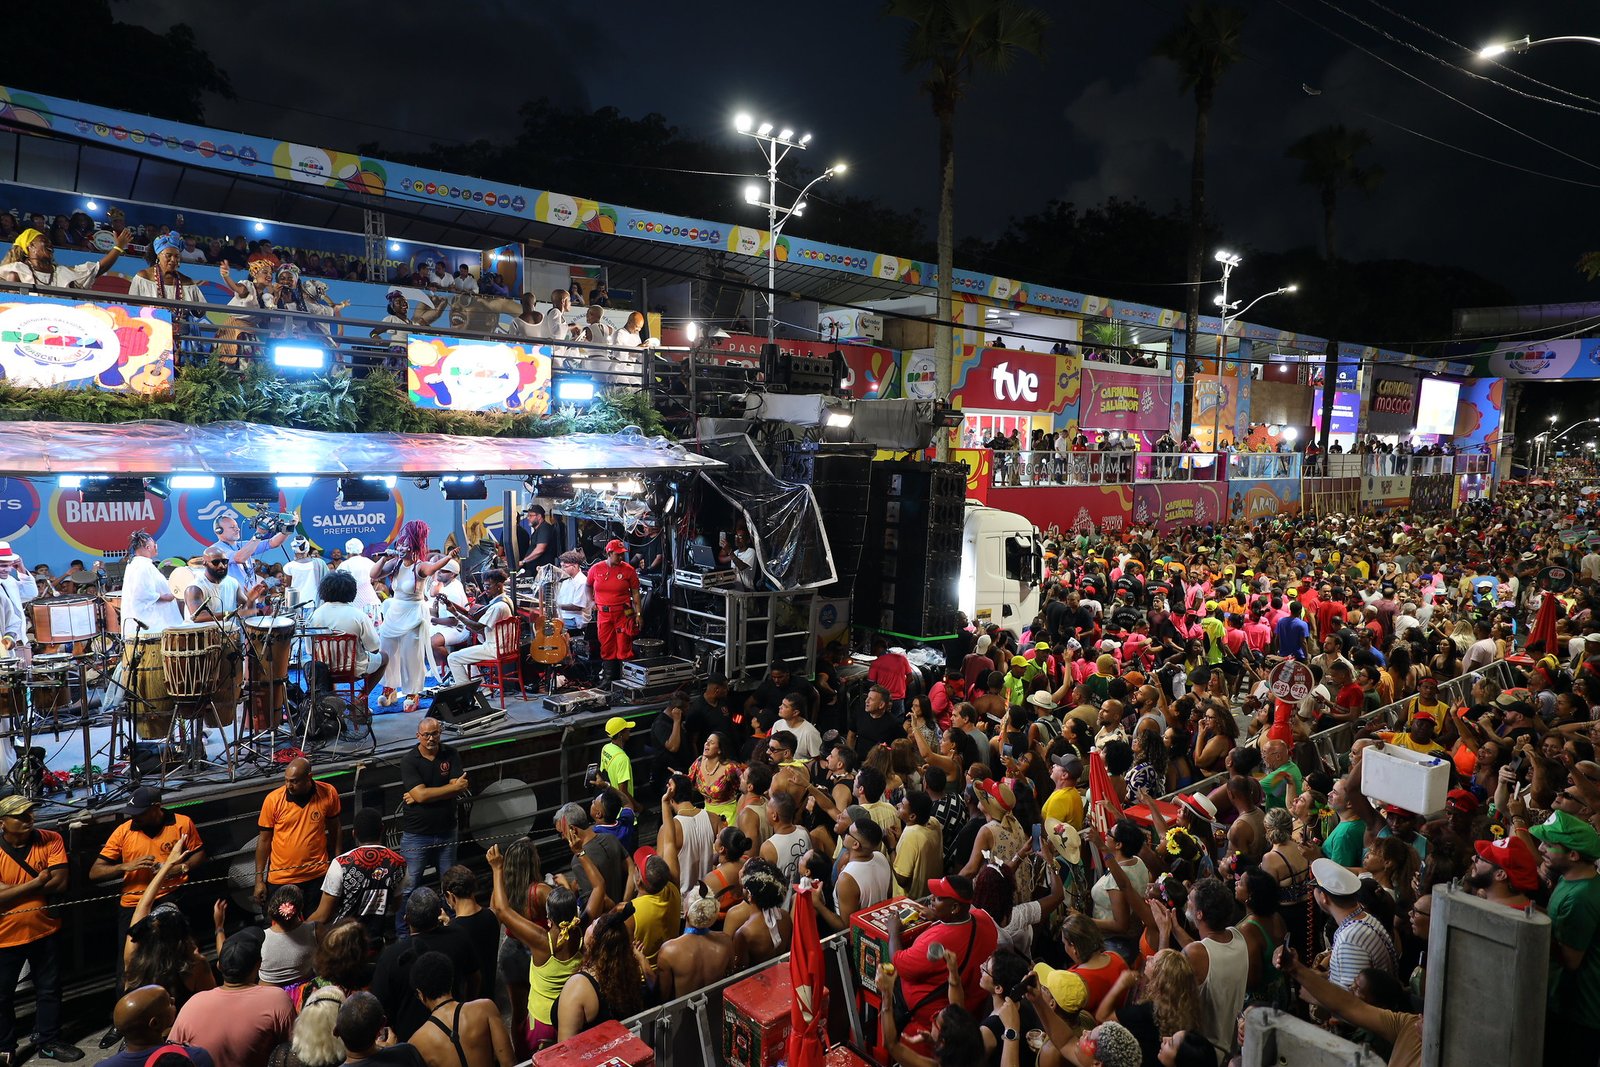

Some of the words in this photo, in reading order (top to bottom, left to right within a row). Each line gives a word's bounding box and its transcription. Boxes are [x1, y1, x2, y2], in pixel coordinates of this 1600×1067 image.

[992, 361, 1039, 403] tve
[65, 498, 156, 523] BRAHMA
[312, 512, 386, 528] SALVADOR
[323, 526, 377, 535] PREFEITURA
